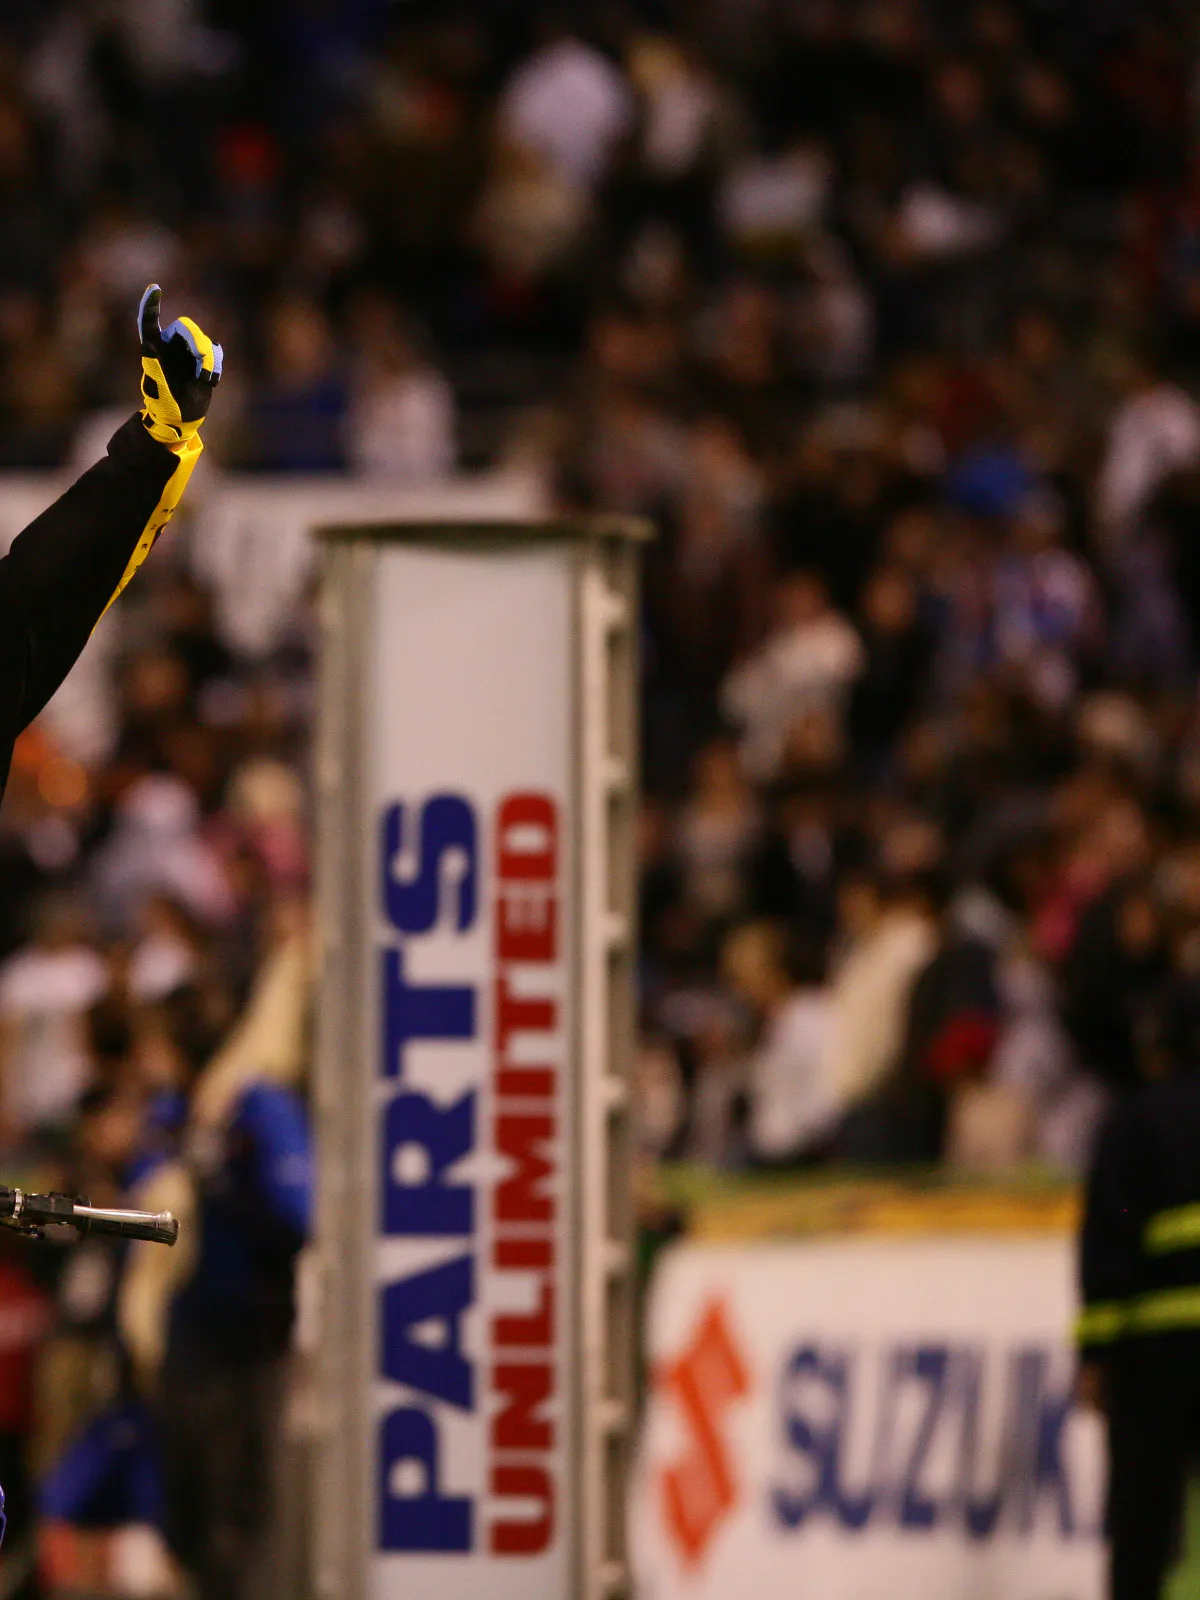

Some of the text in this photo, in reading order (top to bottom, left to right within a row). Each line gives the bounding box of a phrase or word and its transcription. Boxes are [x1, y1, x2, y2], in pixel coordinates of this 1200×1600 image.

[377, 789, 479, 1554] PARTS
[488, 789, 560, 1557] UNLIMITED
[770, 1337, 1110, 1540] SUZUK
